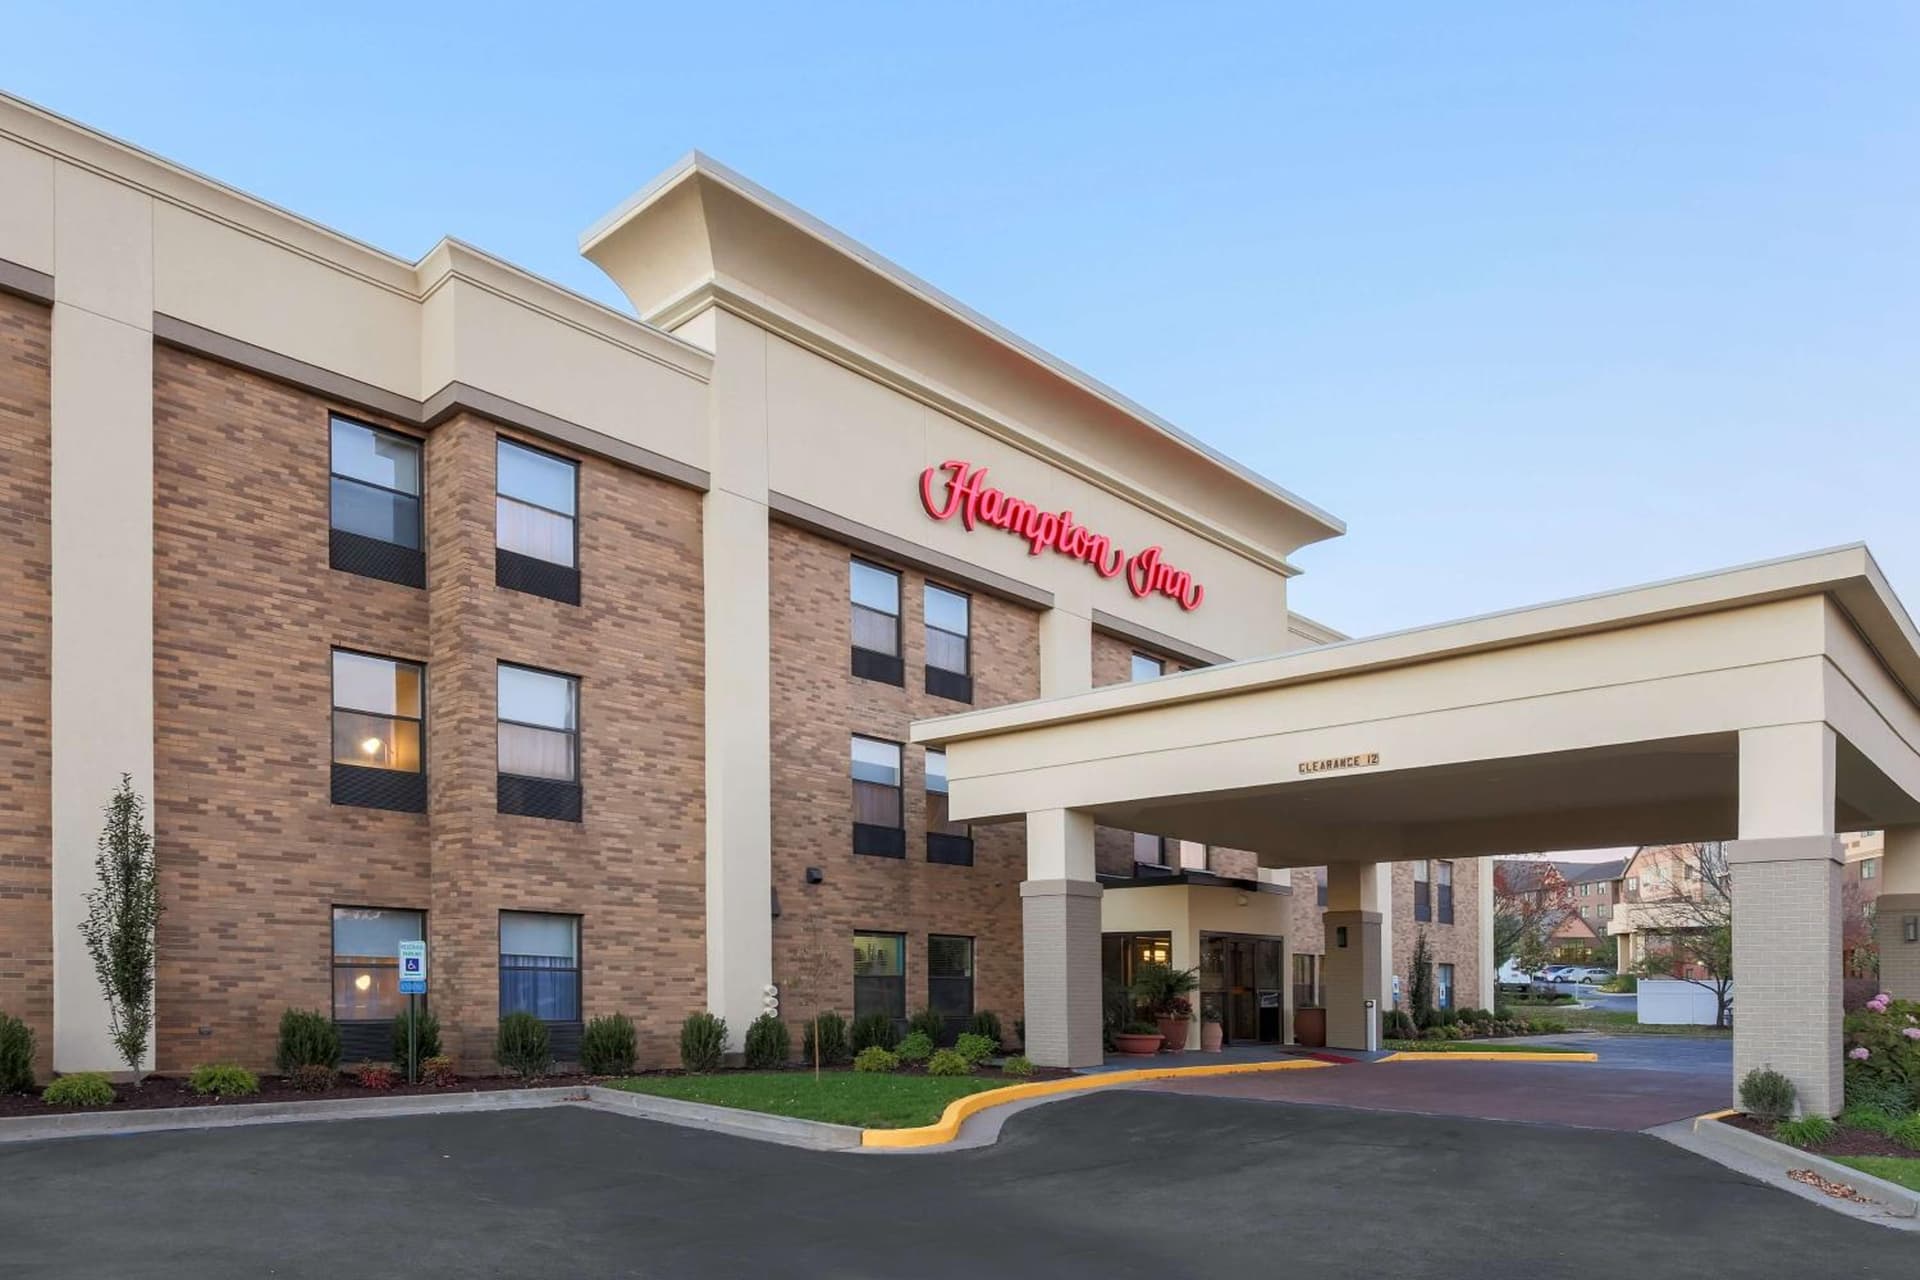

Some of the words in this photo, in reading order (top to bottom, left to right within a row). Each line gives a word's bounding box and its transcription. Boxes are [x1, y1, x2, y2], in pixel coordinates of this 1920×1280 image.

[919, 460, 1125, 578] Hampton
[1126, 545, 1205, 612] Inn
[1298, 755, 1361, 773] CLEARANCE
